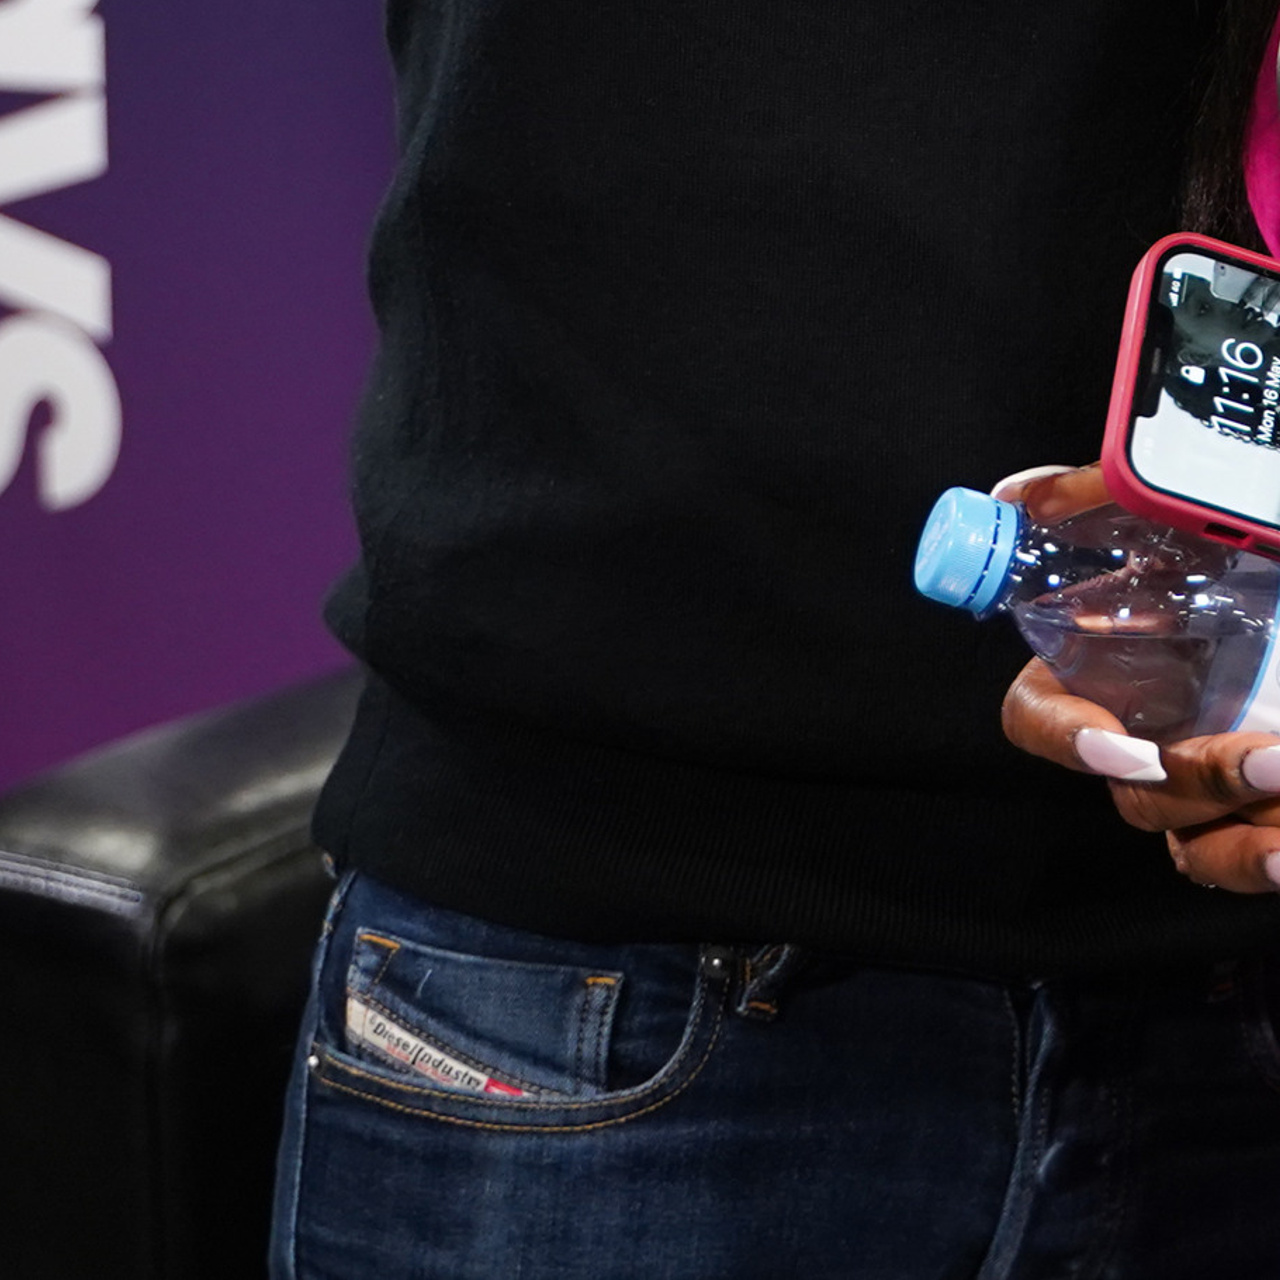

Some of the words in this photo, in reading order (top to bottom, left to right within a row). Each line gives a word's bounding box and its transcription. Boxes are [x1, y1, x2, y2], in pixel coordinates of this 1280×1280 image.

[1209, 337, 1264, 434] 11:16
[1263, 388, 1280, 407] 16
[1256, 409, 1276, 442] Mon
